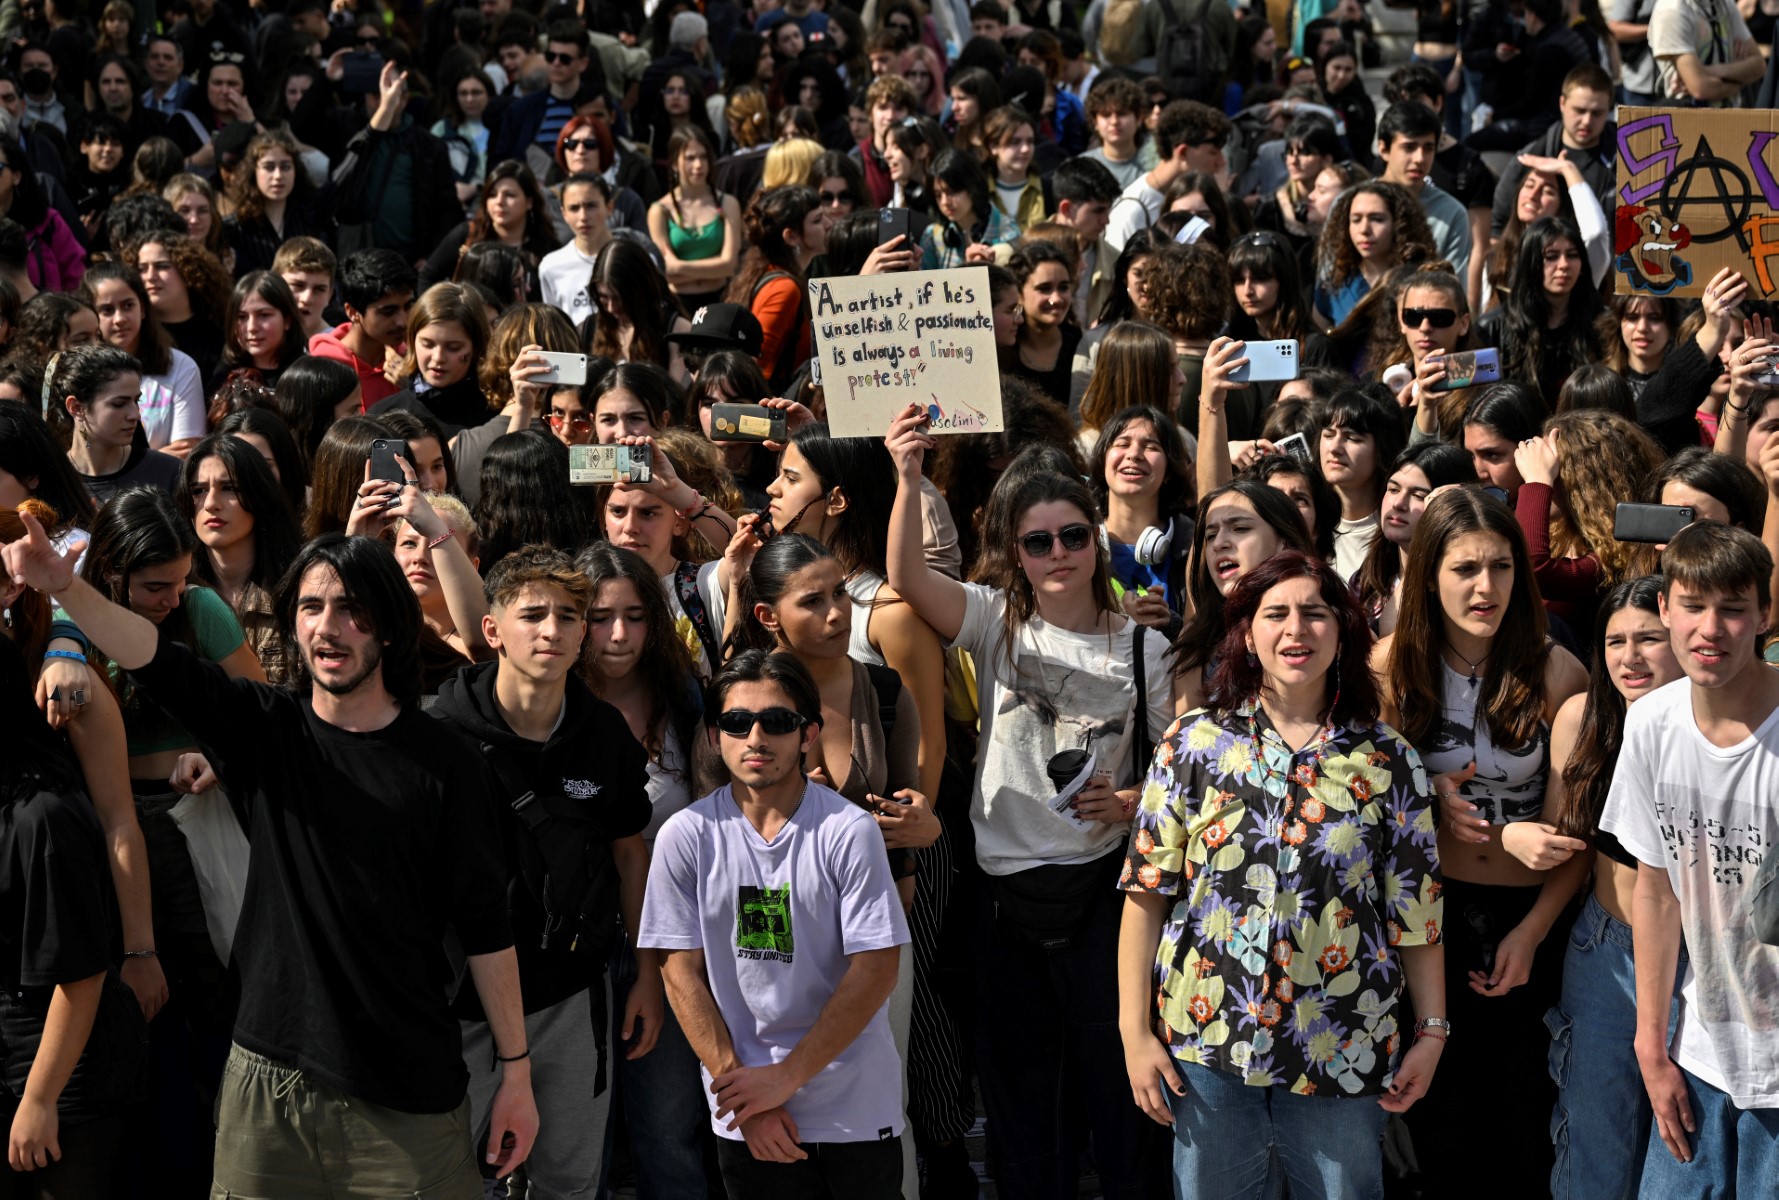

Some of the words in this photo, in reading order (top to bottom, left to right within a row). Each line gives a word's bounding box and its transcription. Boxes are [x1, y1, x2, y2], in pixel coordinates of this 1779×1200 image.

[917, 280, 934, 306] if
[943, 280, 975, 304] he's
[897, 312, 911, 331] &
[915, 310, 993, 339] passionate,
[832, 346, 847, 366] is
[853, 341, 906, 370] always
[909, 345, 921, 359] a
[930, 339, 974, 364] living
[737, 949, 763, 960] STAY
